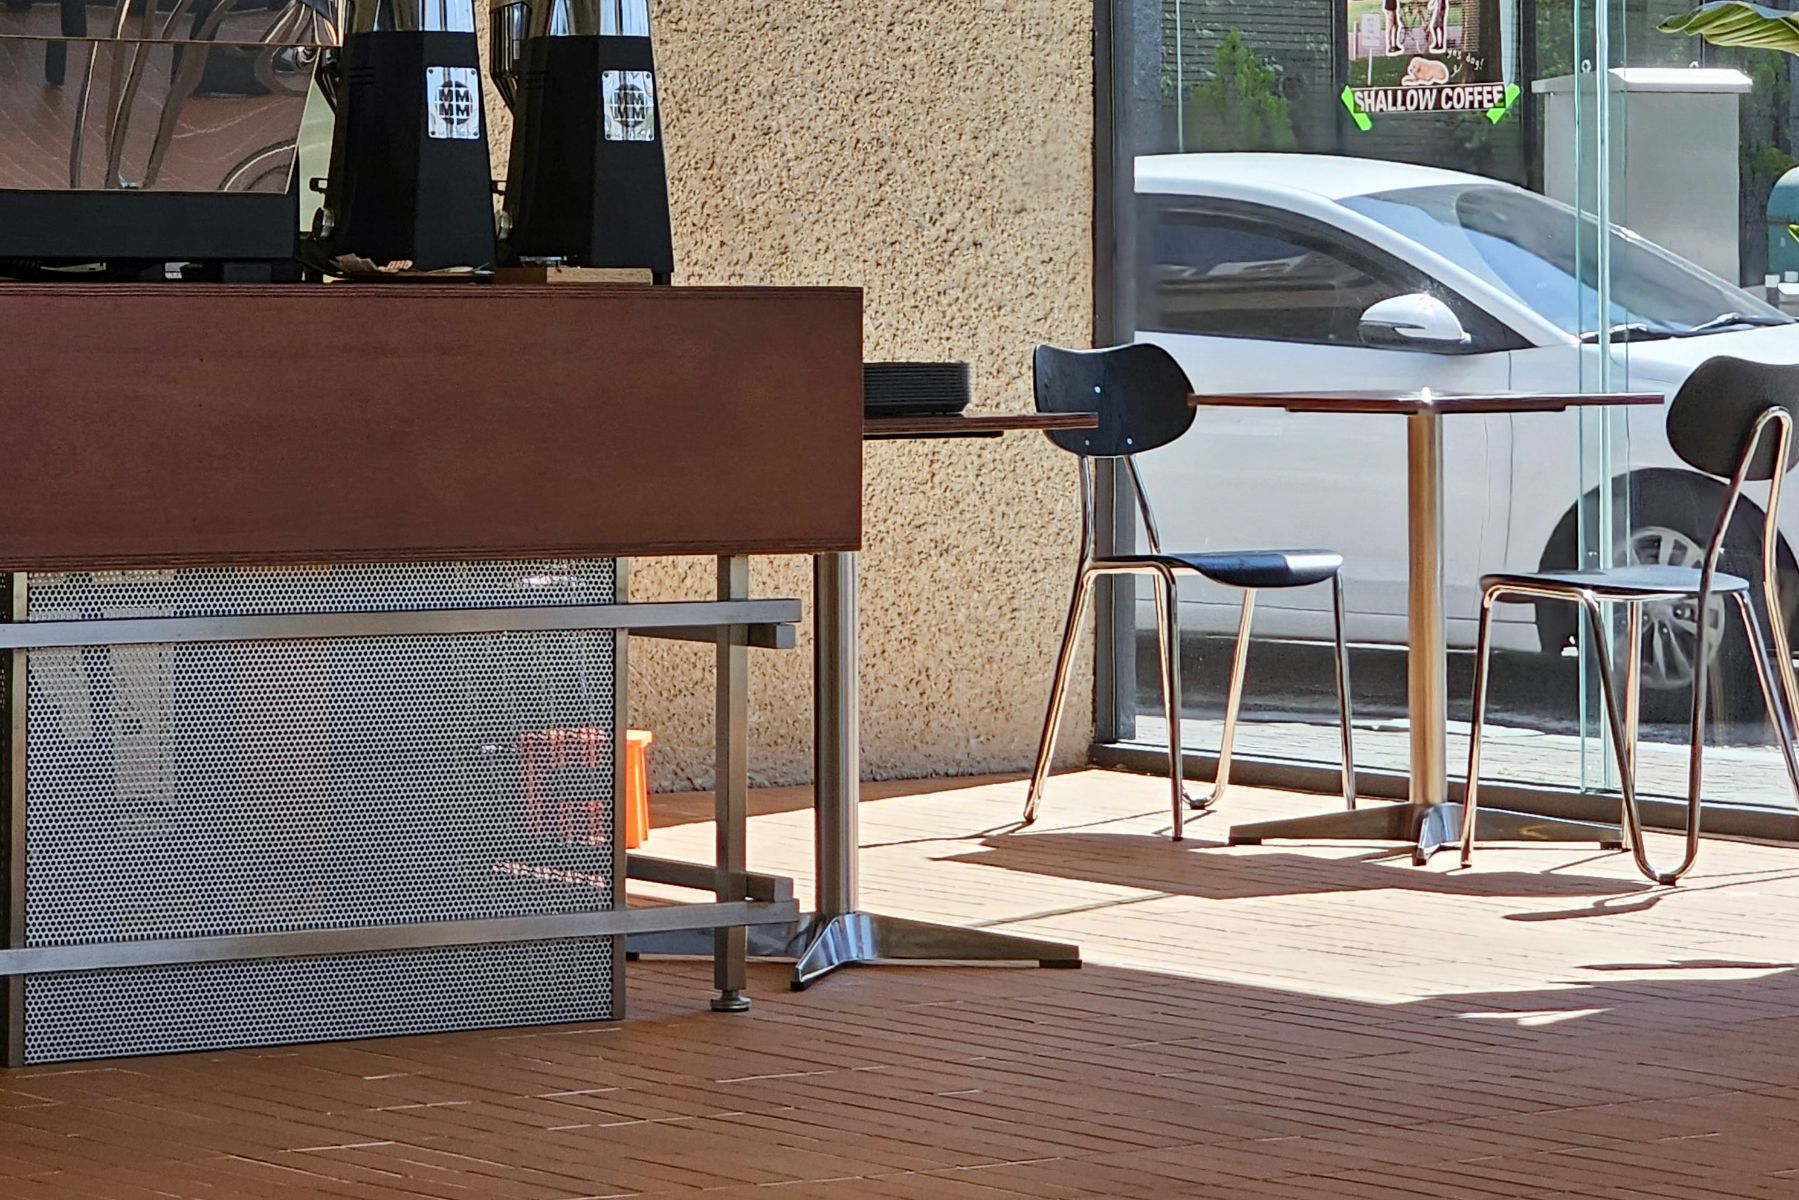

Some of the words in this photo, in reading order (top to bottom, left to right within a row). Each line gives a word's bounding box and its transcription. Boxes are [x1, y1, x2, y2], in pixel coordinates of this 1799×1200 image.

[1465, 52, 1485, 71] dog!
[1354, 88, 1437, 112] SHALLOW
[1440, 85, 1503, 110] COFFEE
